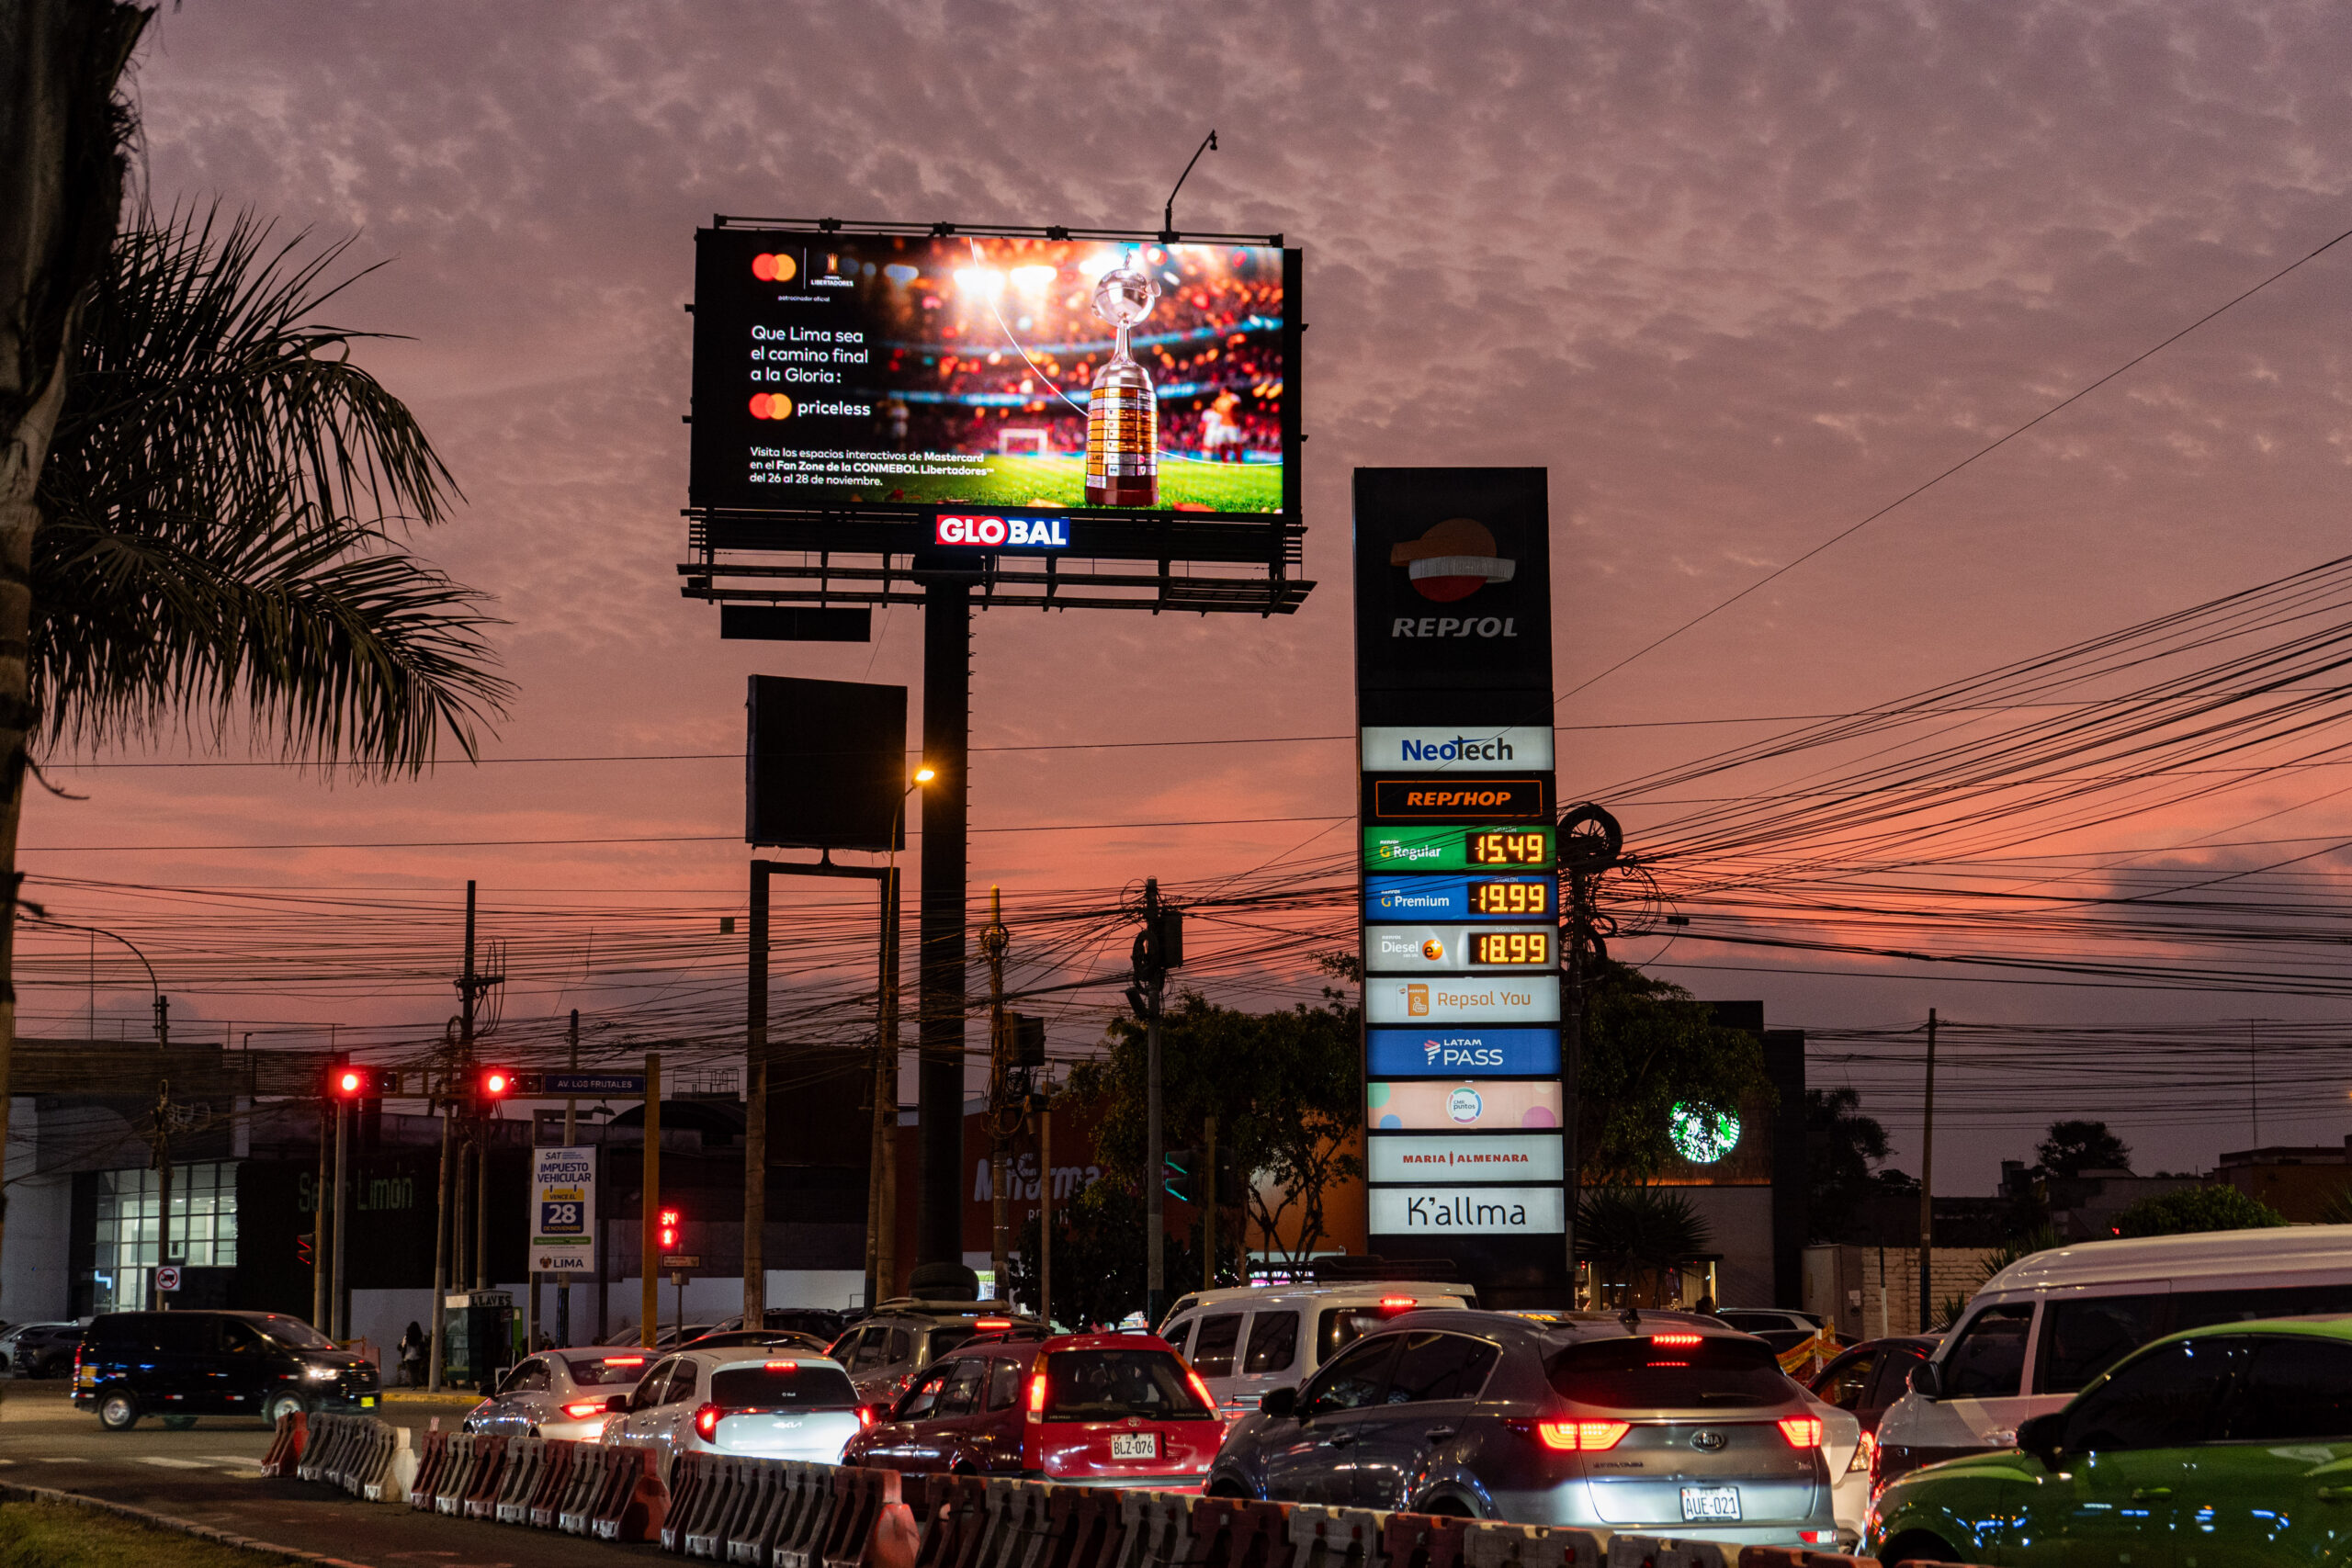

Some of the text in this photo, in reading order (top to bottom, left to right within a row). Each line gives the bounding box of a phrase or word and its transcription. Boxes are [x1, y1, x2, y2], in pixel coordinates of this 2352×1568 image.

[752, 324, 864, 344] Que Lima sea
[751, 345, 868, 364] el camino final
[750, 369, 762, 381] a
[765, 367, 781, 381] la
[797, 400, 871, 416] priceless
[750, 446, 984, 462] Visita los espacios interactivos de Mastercard
[750, 461, 763, 469] en
[764, 460, 775, 470] el
[775, 460, 797, 470] Fan
[797, 460, 825, 471] Zone
[826, 462, 840, 471] de
[841, 462, 852, 472] la
[853, 463, 920, 474] CONMEBOL
[750, 472, 883, 486] del 26 al 28 de noviembre.
[940, 517, 1067, 545] GLOBAL
[1392, 616, 1518, 637] REPSOL
[1407, 792, 1511, 807] REPSHOP
[1394, 845, 1441, 861] Regular
[1395, 895, 1450, 908] Premium
[1382, 941, 1419, 953] Diesel
[1480, 935, 1545, 962] 18.99
[1438, 991, 1531, 1010] Repsol You
[1444, 1049, 1503, 1066] PASS
[557, 1080, 570, 1089] AV.
[545, 1152, 562, 1160] SAT
[1403, 1154, 1529, 1163] MARIA ALMENARA
[540, 1162, 589, 1172] IMPUESTO
[537, 1173, 592, 1183] VEHICULAR
[548, 1204, 577, 1224] 28
[662, 1212, 676, 1225] 34
[553, 1258, 584, 1268] LIMA
[470, 1295, 512, 1305] LLAVES
[1114, 1440, 1153, 1456] BLZ-076
[1686, 1496, 1736, 1516] AUE-021
